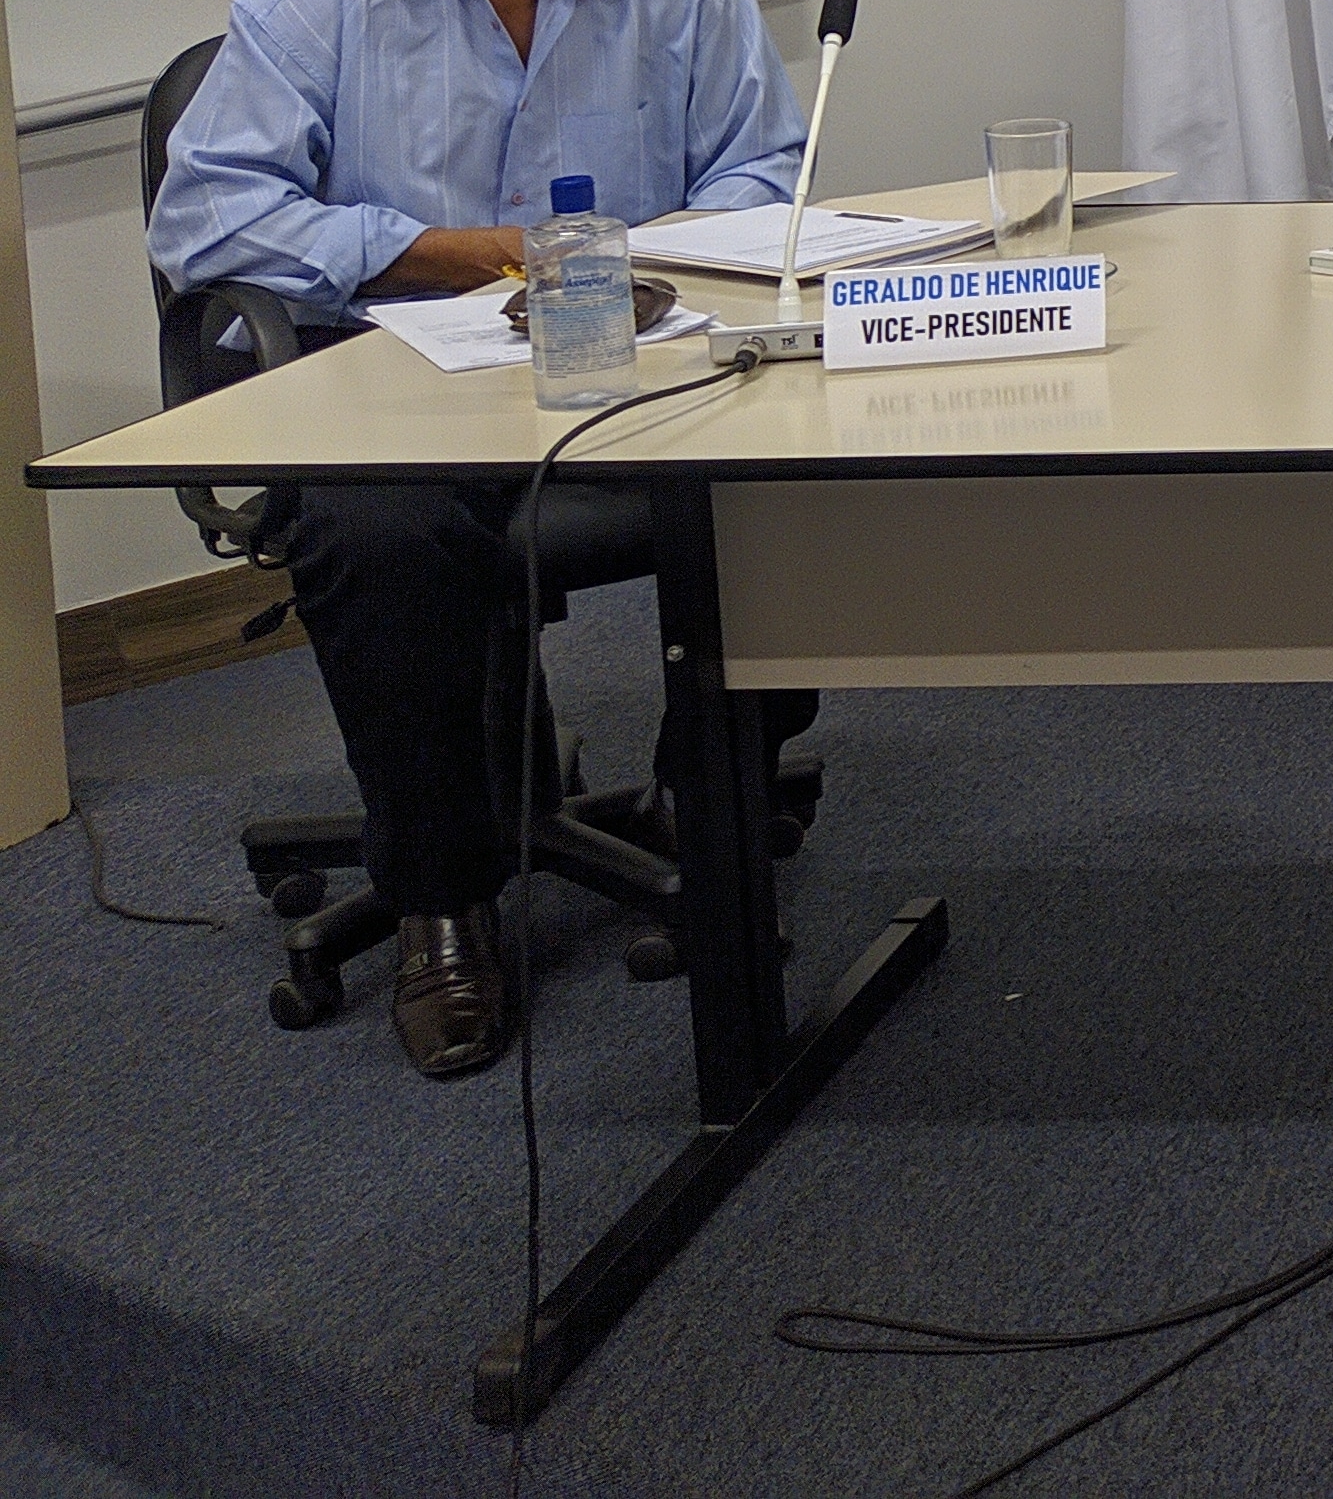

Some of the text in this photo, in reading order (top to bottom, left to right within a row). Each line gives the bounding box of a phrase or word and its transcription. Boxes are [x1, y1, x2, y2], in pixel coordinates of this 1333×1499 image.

[832, 264, 1100, 306] GERALDO DE HENRIQUE
[861, 306, 1072, 344] VICE-PRESIDENTE
